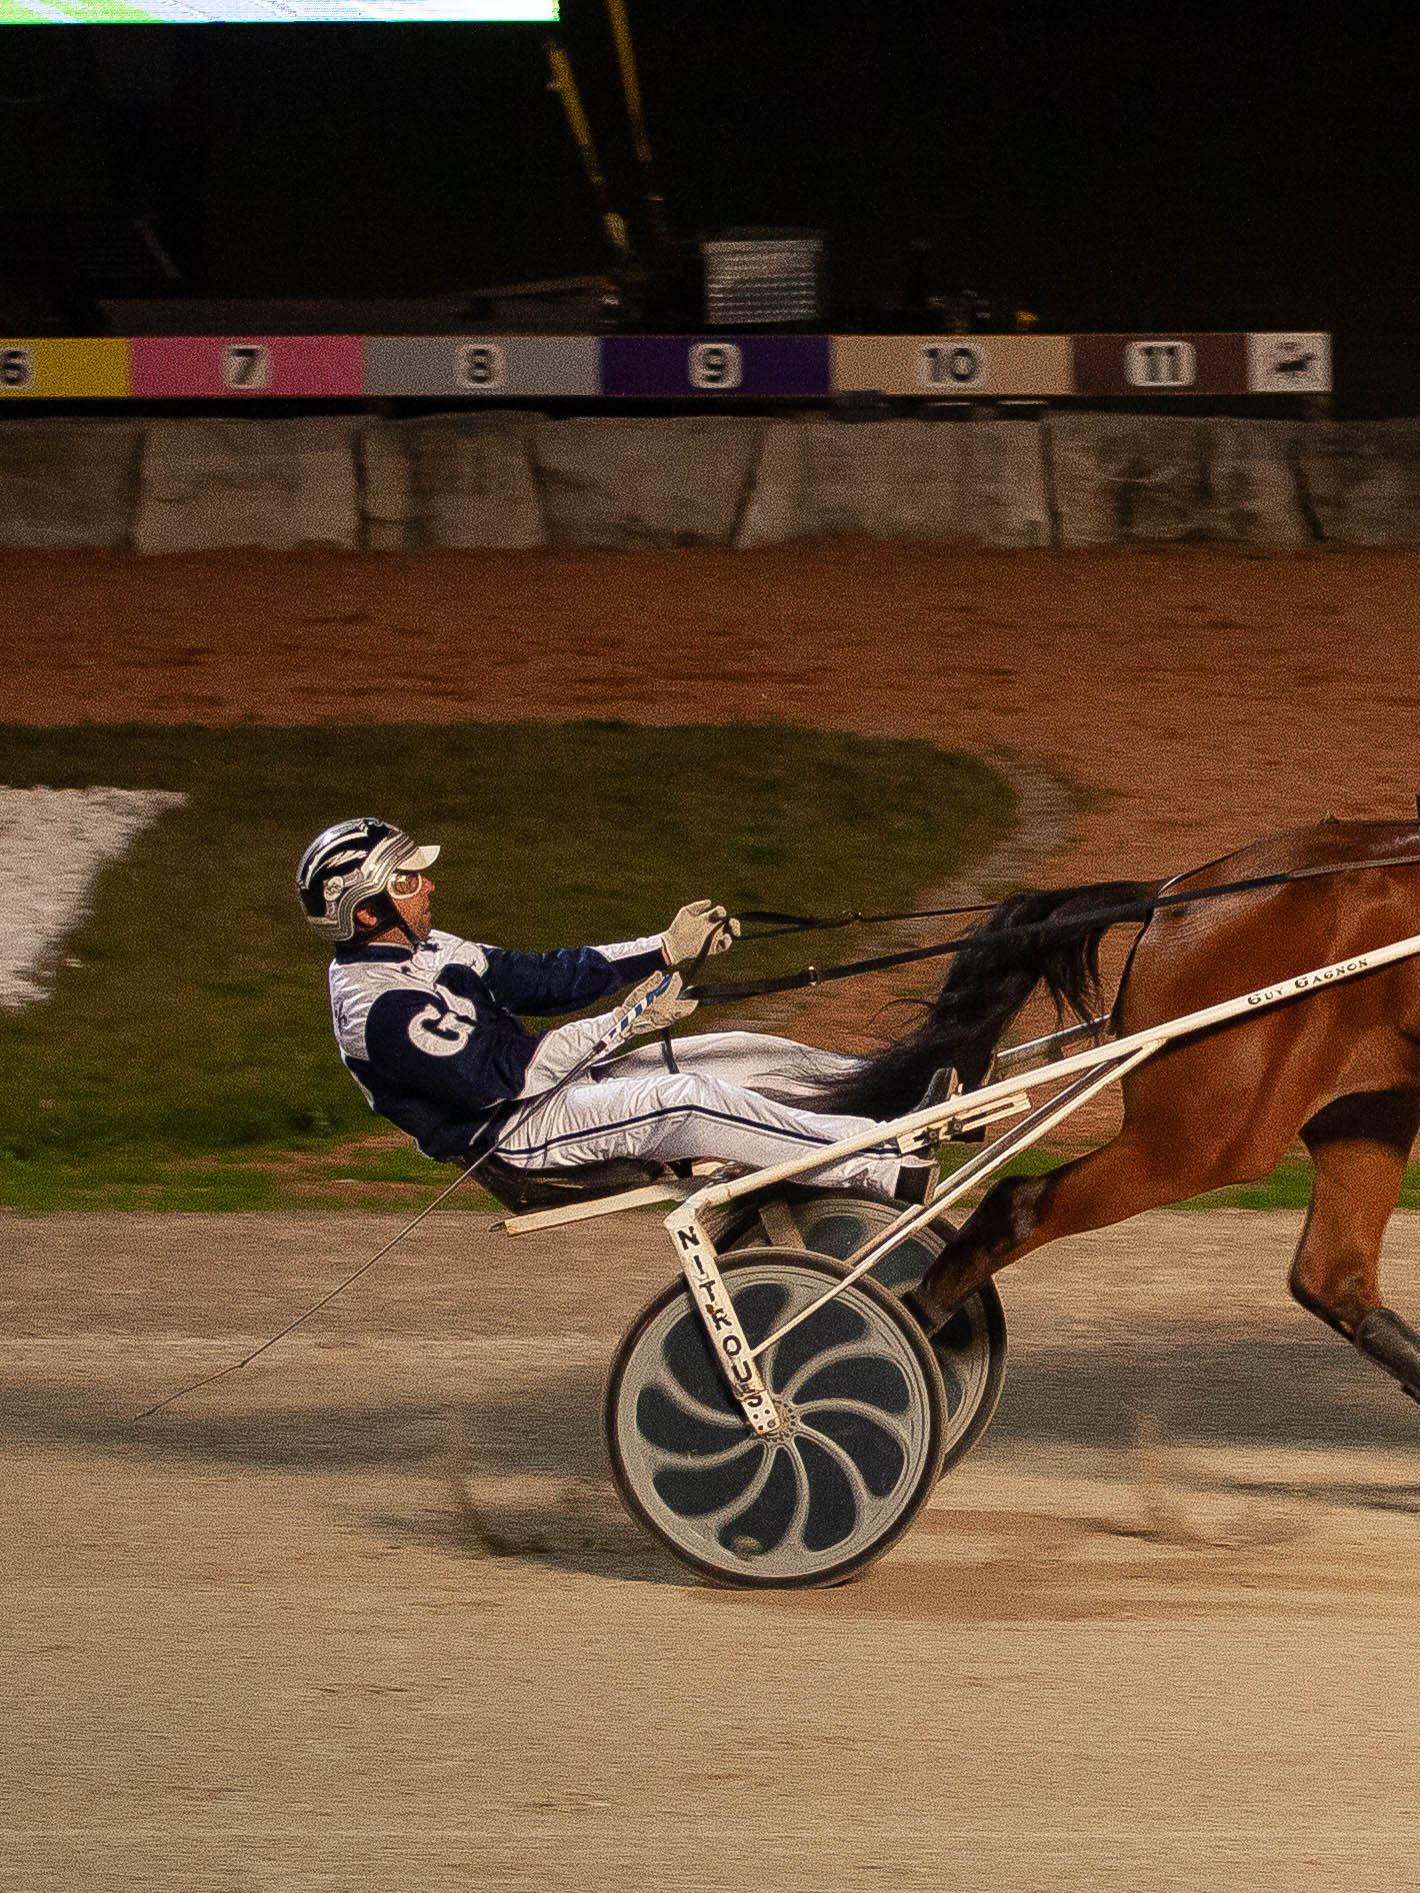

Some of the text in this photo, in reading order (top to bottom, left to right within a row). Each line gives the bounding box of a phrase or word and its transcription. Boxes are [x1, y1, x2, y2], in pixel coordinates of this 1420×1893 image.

[231, 347, 258, 386] 7
[459, 347, 493, 385] 8
[700, 347, 729, 383] 9
[925, 346, 979, 384] 10
[1140, 344, 1182, 385] 11
[677, 1225, 764, 1408] NITROUS
